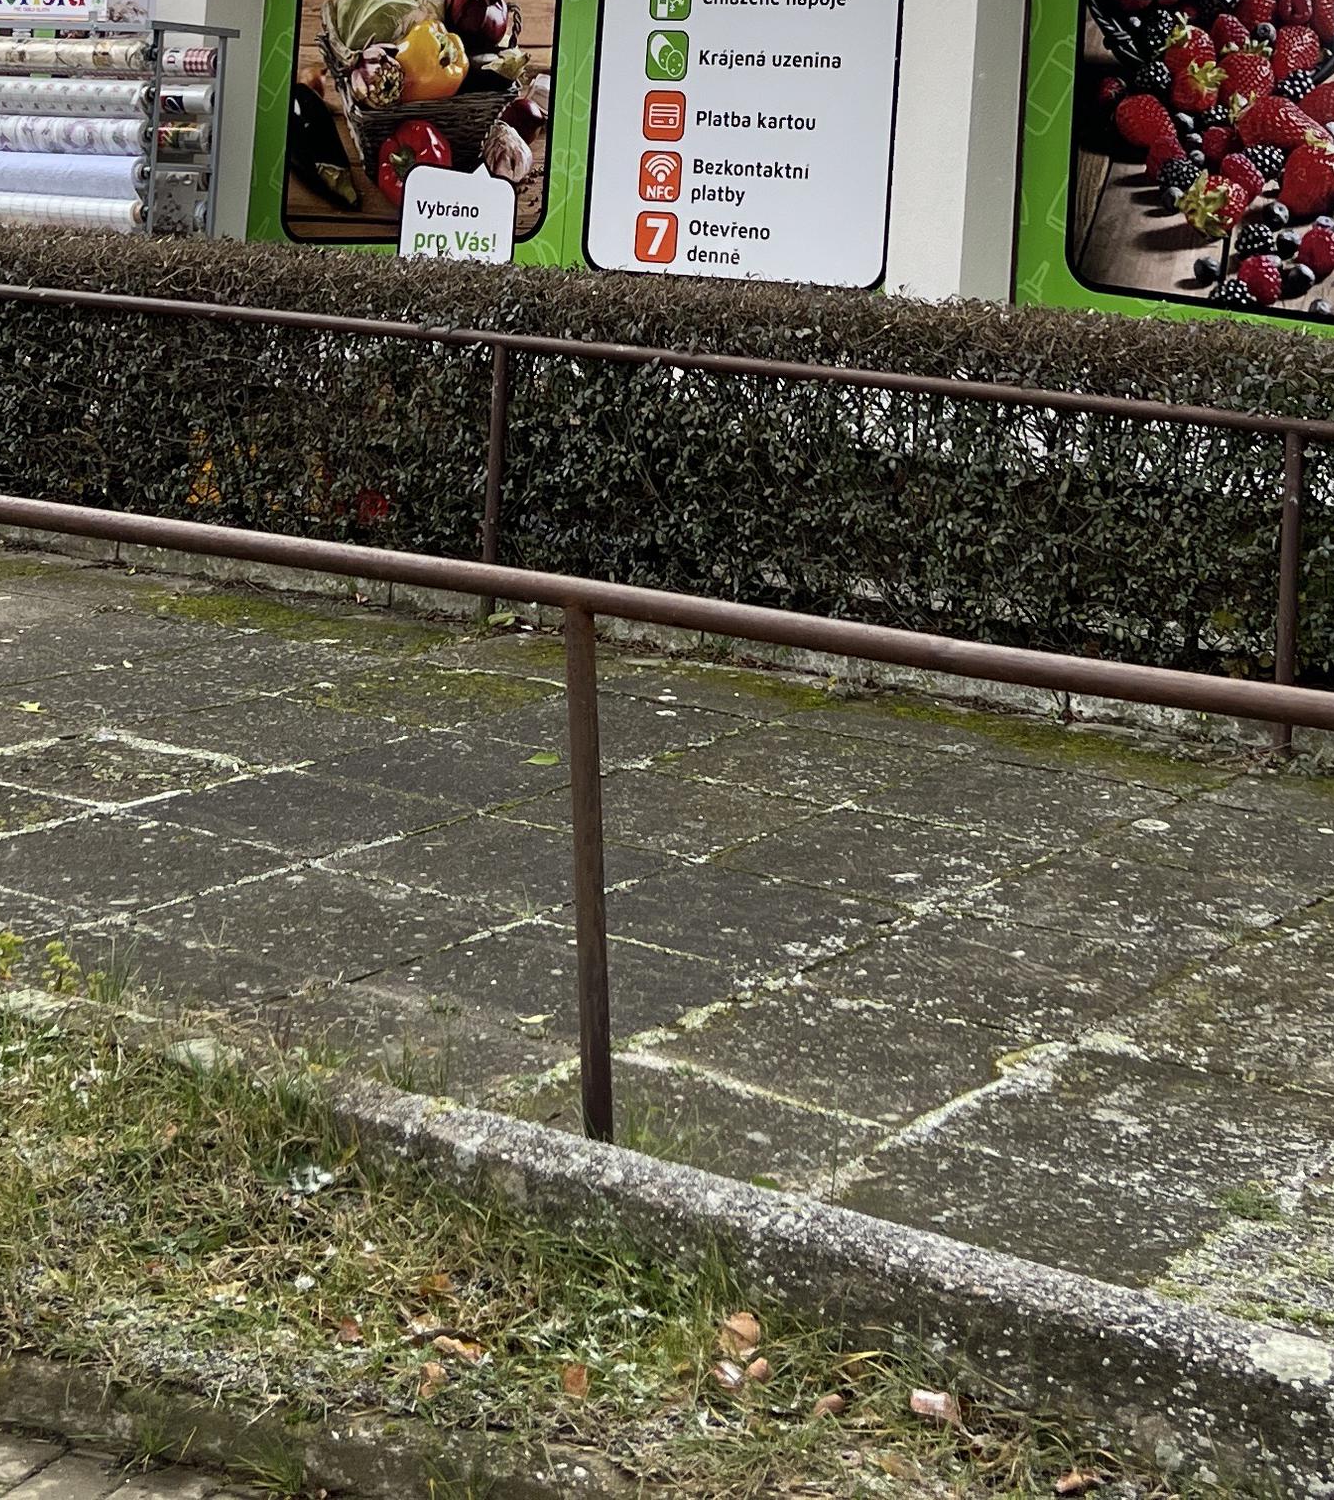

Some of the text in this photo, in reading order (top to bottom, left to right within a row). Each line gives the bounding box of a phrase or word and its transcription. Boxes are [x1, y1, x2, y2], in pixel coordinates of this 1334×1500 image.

[699, 50, 842, 70] Krájená uzenina
[696, 110, 816, 131] Platba kartou
[693, 158, 810, 180] Bezkontaktní
[646, 184, 674, 200] NFC
[691, 184, 745, 207] platby
[416, 199, 480, 219] Vybráno
[646, 217, 670, 257] 7
[689, 219, 771, 240] Otevřeno
[454, 230, 497, 253] Vás!
[687, 245, 741, 265] denně
